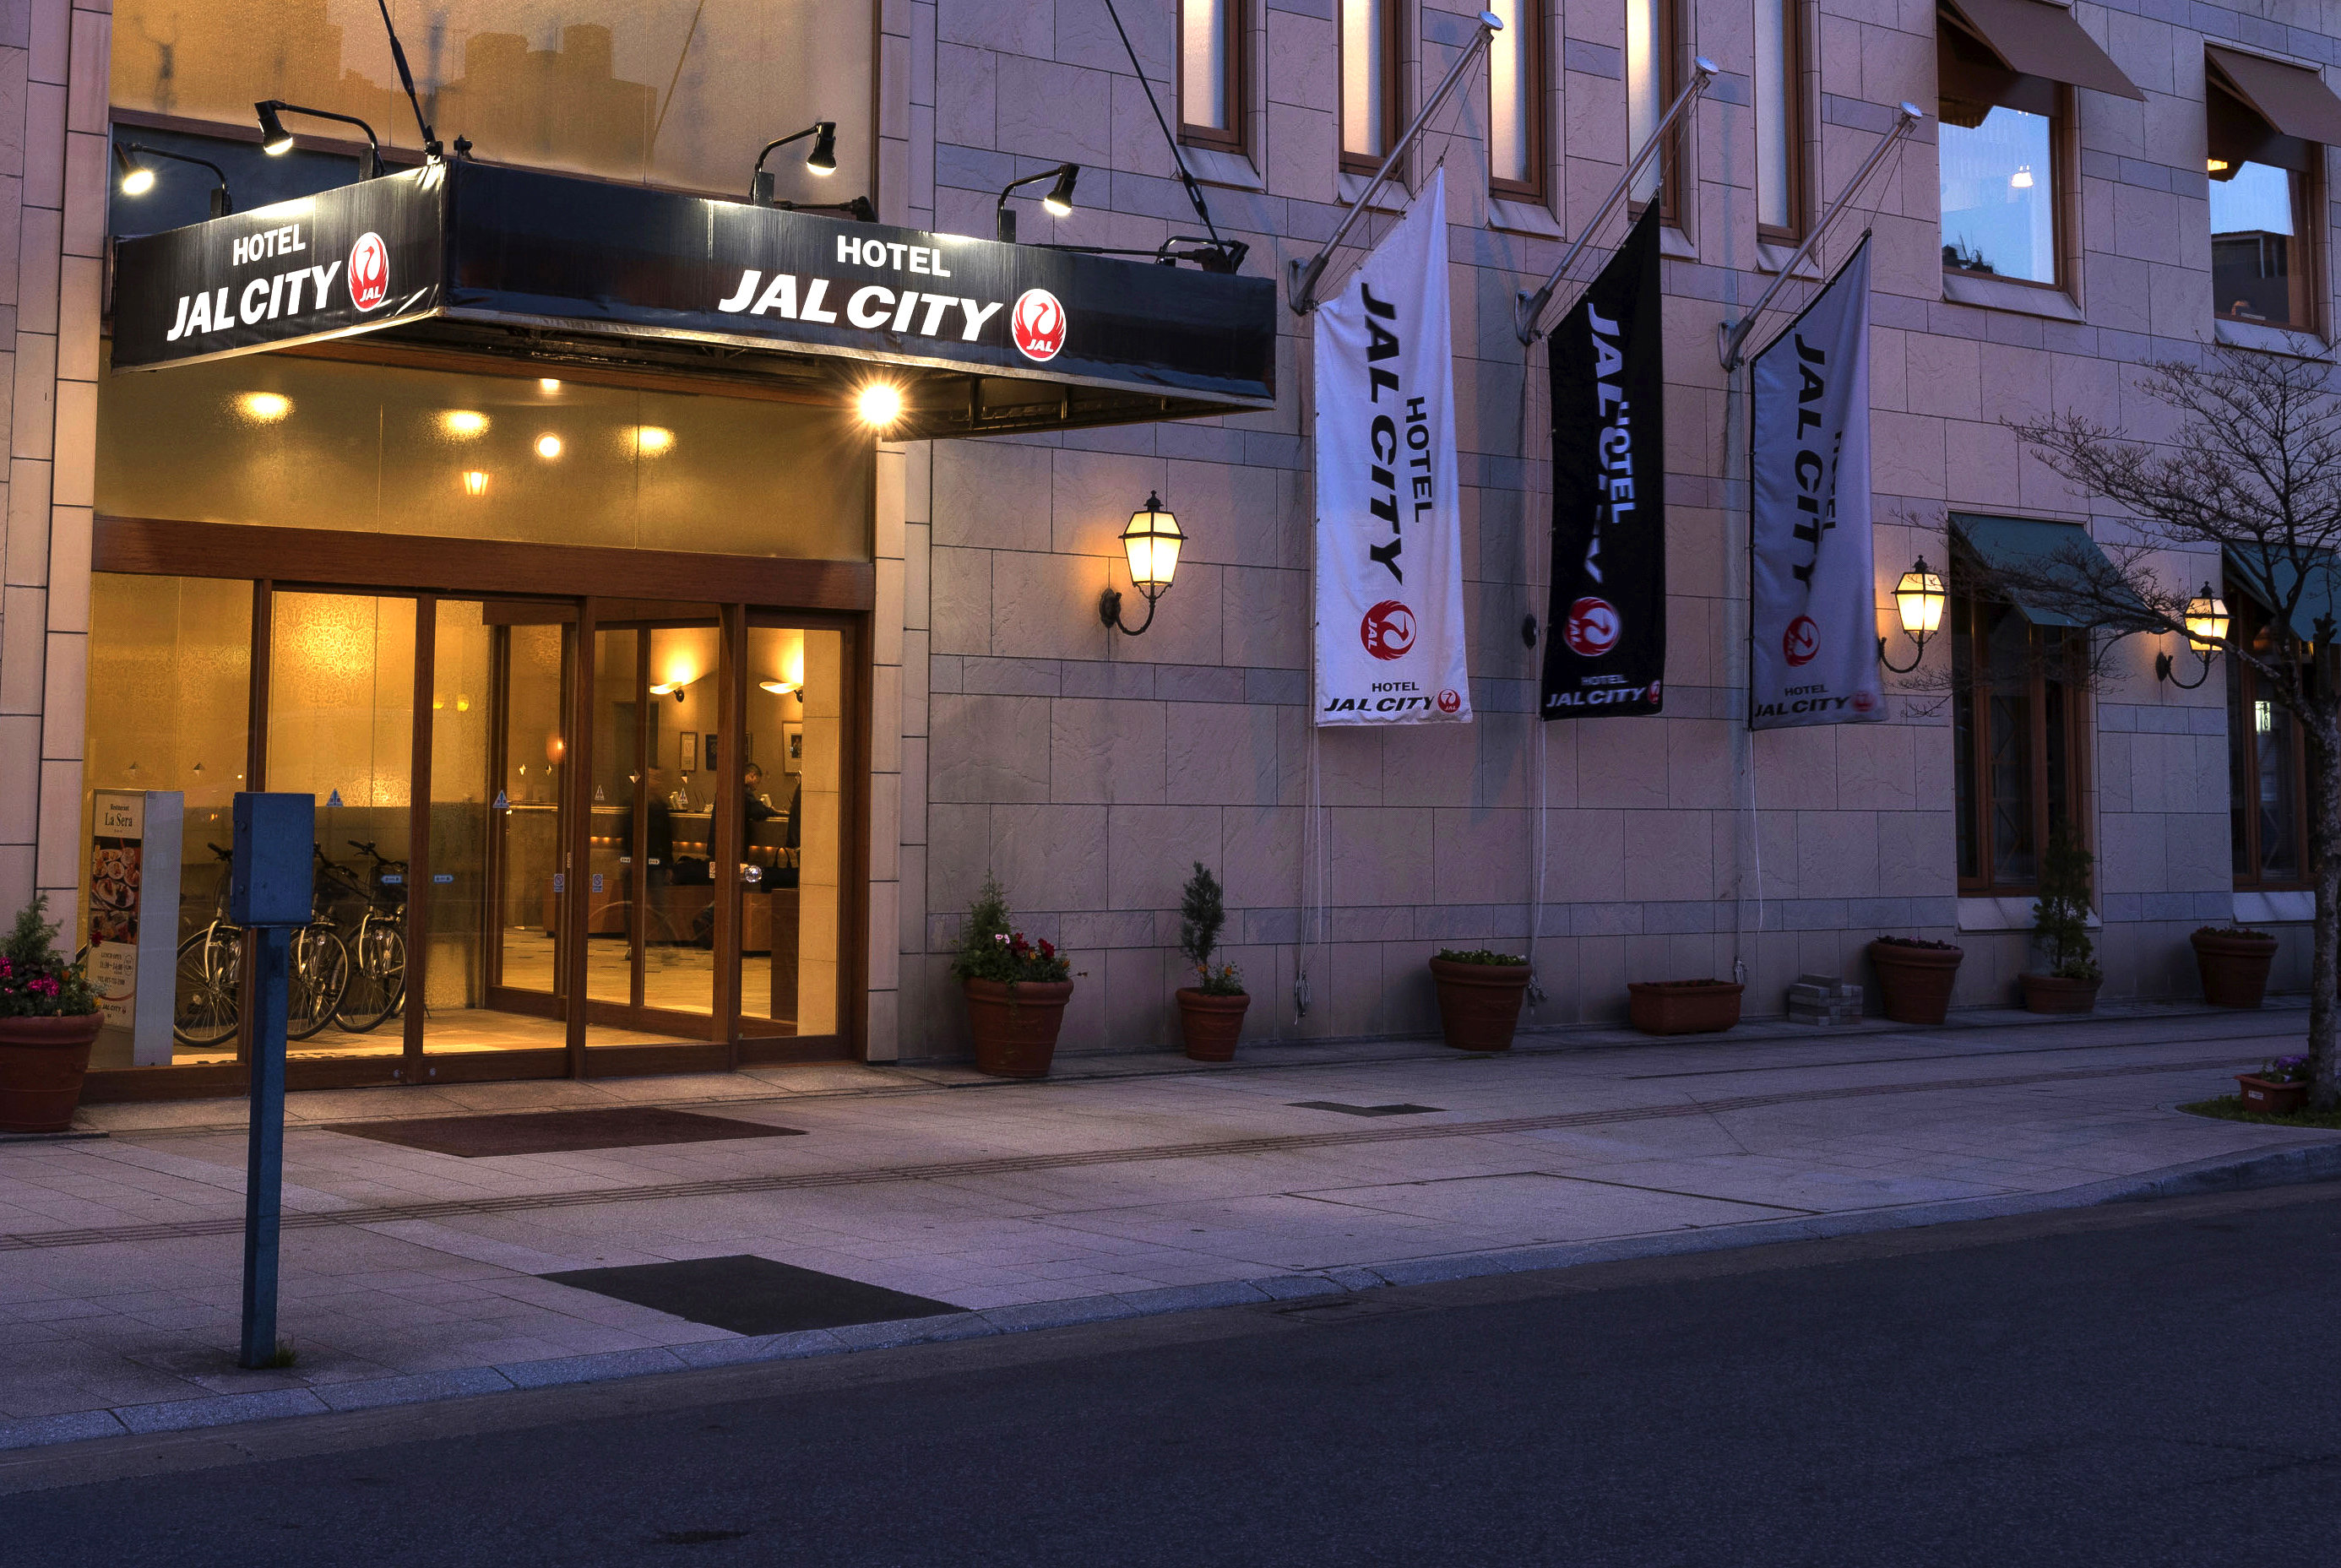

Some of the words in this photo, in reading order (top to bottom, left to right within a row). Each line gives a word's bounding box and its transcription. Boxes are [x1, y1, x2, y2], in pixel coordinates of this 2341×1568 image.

[232, 223, 307, 266] HOTEL
[837, 235, 951, 277] HOTEL
[166, 286, 236, 341] JAL
[240, 260, 342, 325] CITY
[359, 285, 382, 302] JAL
[718, 269, 838, 323] JAL
[846, 285, 1003, 341] CITY
[1025, 339, 1055, 353] JAL
[1361, 281, 1400, 404] JAL
[1587, 302, 1623, 417] JAL
[1795, 334, 1825, 441] JAL
[1405, 396, 1433, 523] HOTEL
[1370, 415, 1403, 586] CITY
[1367, 617, 1378, 649] JAL
[1371, 681, 1420, 692] HOTEL
[1581, 675, 1629, 686] HOTEL
[1784, 684, 1829, 697] HOTEL
[1323, 697, 1371, 712] JAL
[1376, 696, 1436, 712] CITY
[1545, 691, 1586, 708] JAL
[1587, 686, 1647, 705] CITY
[1754, 703, 1790, 717] JAL
[1791, 697, 1851, 713] CITY
[105, 811, 115, 826] La
[117, 812, 133, 827] Sera
